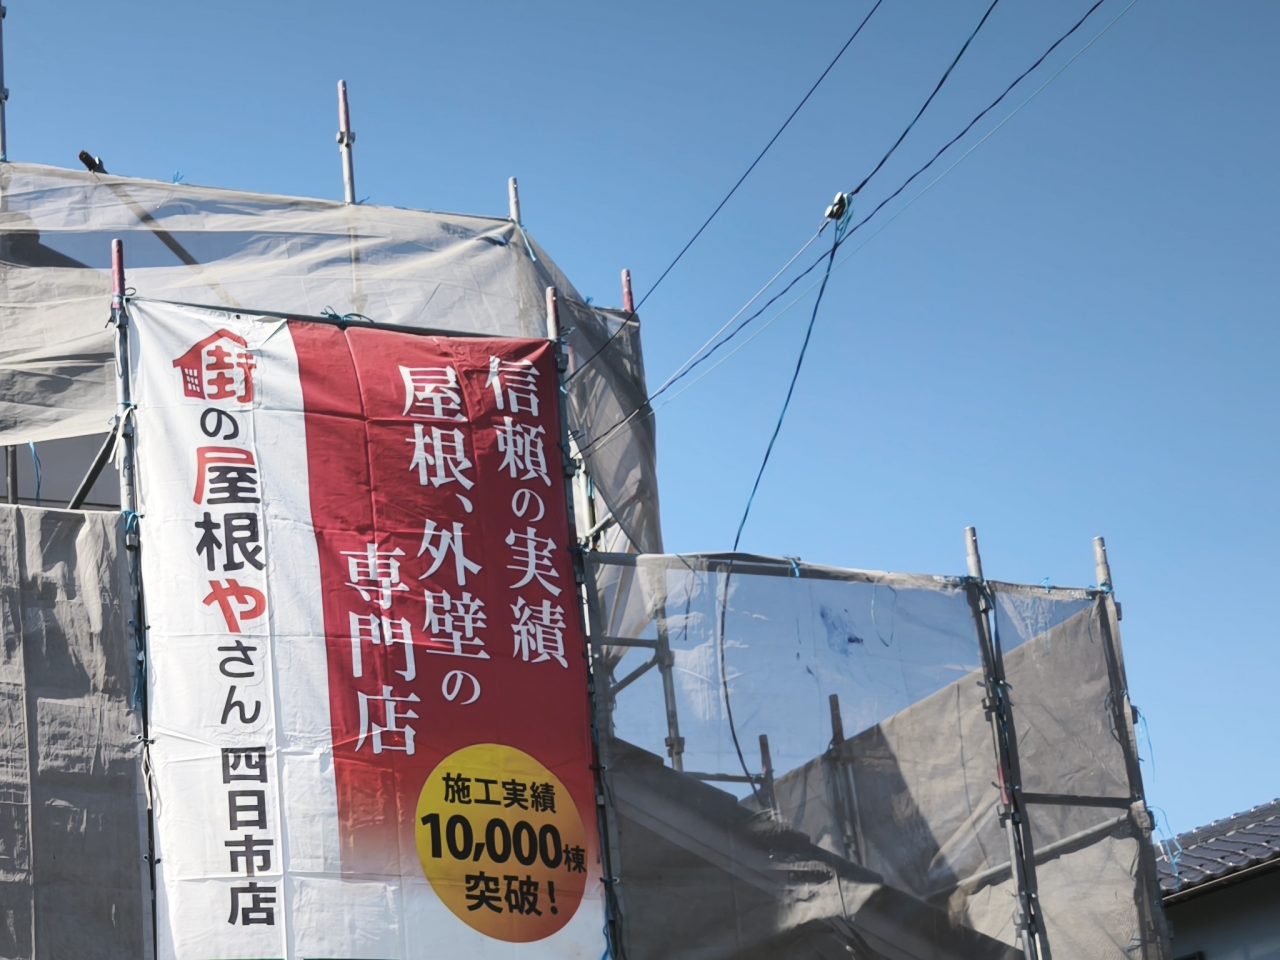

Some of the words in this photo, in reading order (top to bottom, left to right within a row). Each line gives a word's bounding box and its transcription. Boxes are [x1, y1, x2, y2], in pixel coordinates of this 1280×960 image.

[173, 328, 267, 726] 街の屋根やさん
[221, 746, 277, 926] 四日市店
[398, 364, 491, 706] 屋根、外壁の
[484, 354, 569, 669] 信頼の実績
[339, 542, 422, 756] 専門店
[421, 812, 587, 875] 10,000棟
[441, 772, 557, 815] 施工実績
